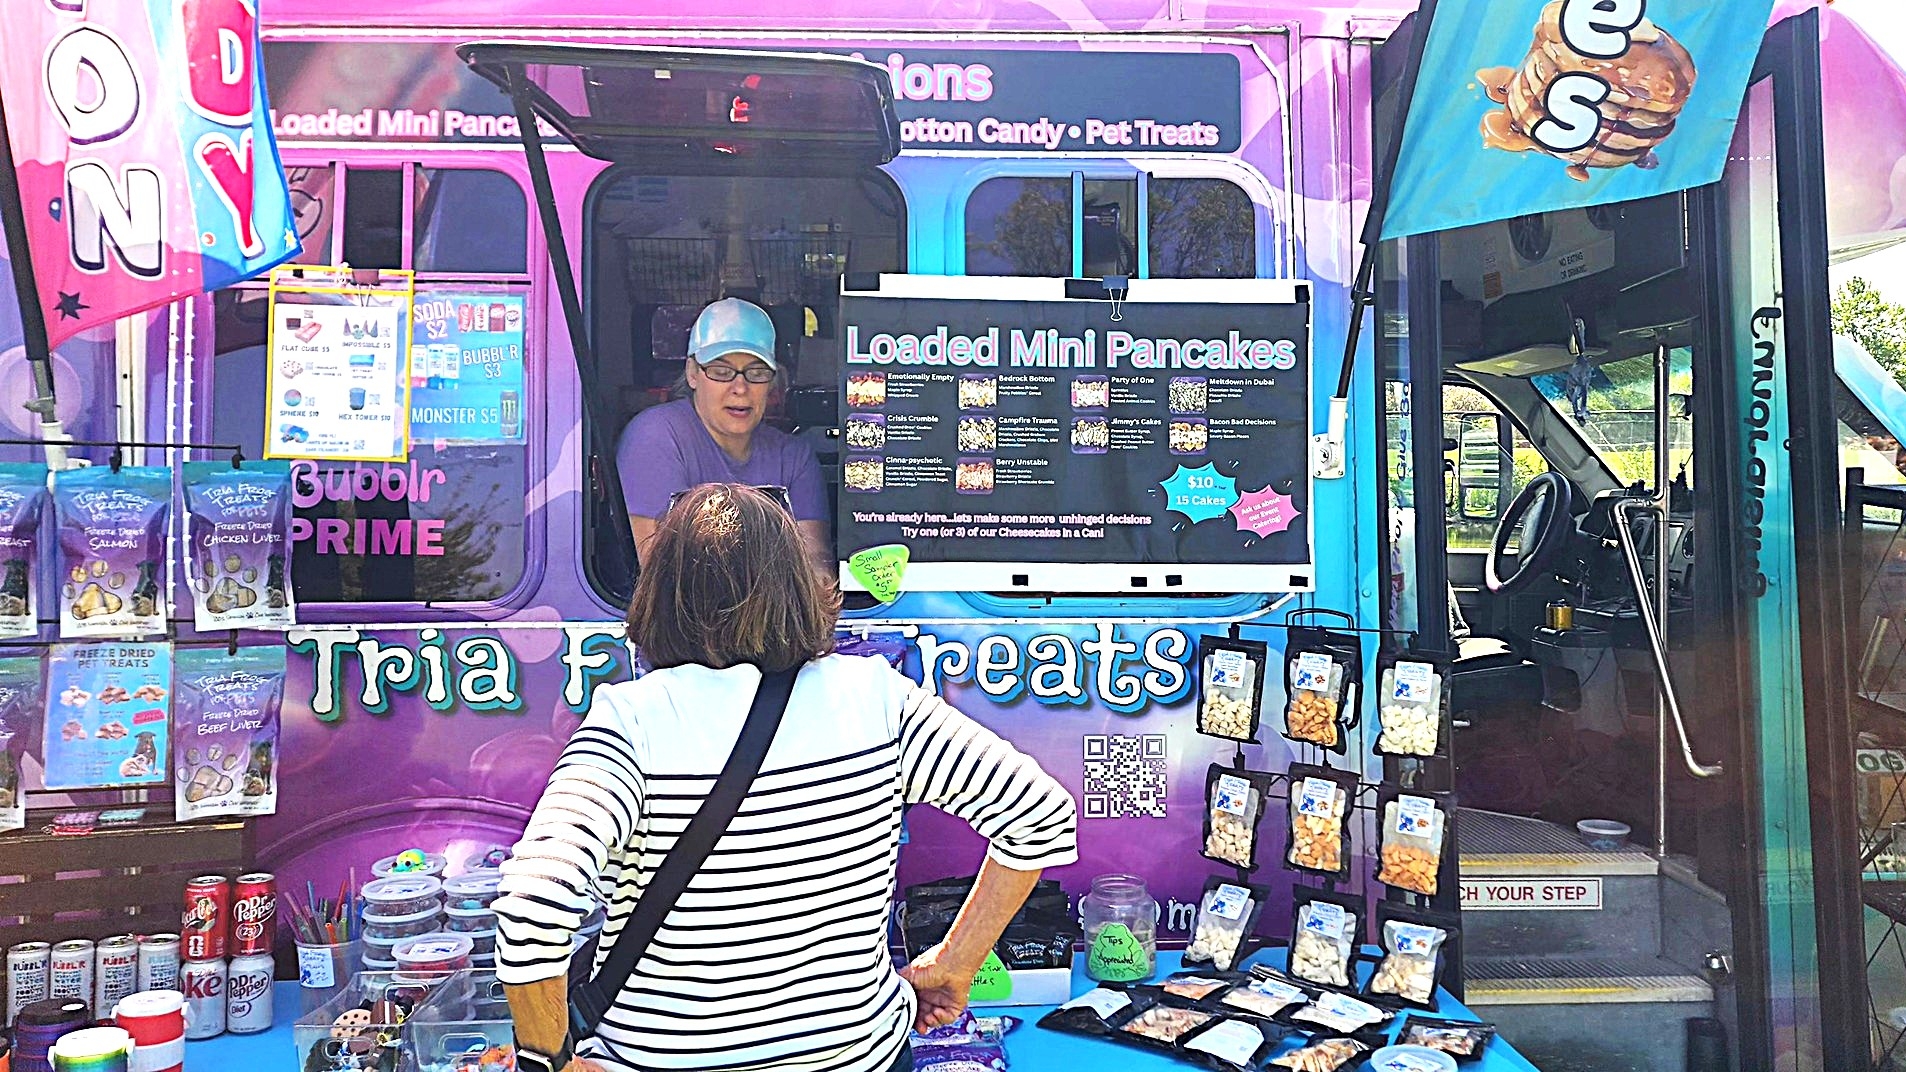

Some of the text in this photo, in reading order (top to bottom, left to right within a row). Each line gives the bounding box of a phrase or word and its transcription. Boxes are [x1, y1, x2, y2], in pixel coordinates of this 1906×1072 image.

[887, 53, 994, 101] ions
[269, 108, 374, 137] Loaded
[378, 108, 440, 137] Mini
[43, 0, 165, 279] ON
[900, 117, 1220, 150] otton Candy Pet Treats
[412, 300, 456, 323] SODA
[846, 326, 1297, 371] Loaded Mini Pancakes
[887, 373, 954, 383] Emotionally Empty
[998, 375, 1055, 383] Bedrock Bottom
[1111, 376, 1128, 386] Party
[1130, 376, 1138, 384] of
[1209, 378, 1275, 386] Meltdown in Dubai
[412, 407, 476, 424] MONSTER
[887, 415, 939, 423] Crisis Crumble
[998, 416, 1058, 425] Campfire Trauma
[1111, 417, 1162, 427] Jimmy's Cakes
[886, 457, 942, 465] Cinna-psychotic
[996, 459, 1016, 468] Berry
[1187, 475, 1214, 489] $10
[202, 486, 233, 500] TRIA
[85, 500, 144, 513] TREATS
[211, 494, 269, 508] TREATS
[1175, 495, 1227, 506] 15 Cakes
[1241, 507, 1255, 515] Ask
[1261, 497, 1281, 509] about
[852, 512, 885, 524] You're
[885, 512, 923, 525] already
[973, 514, 1000, 524] make
[1000, 514, 1028, 524] some
[1029, 514, 1055, 524] more
[1058, 513, 1105, 526] unhinged
[1106, 513, 1152, 525] decisions
[1259, 507, 1279, 518] Event
[214, 522, 246, 532] FREEZE
[901, 527, 918, 538] Try
[919, 528, 939, 537] one
[940, 527, 955, 538] (or
[967, 527, 978, 538] of
[979, 528, 998, 538] our
[998, 527, 1061, 538] Cheesecakes
[1081, 527, 1104, 538] Can!
[89, 536, 138, 550] SALMON
[203, 532, 283, 547] CHICKEN LIVER
[292, 518, 445, 556] PRIME
[855, 551, 883, 567] Small
[73, 648, 156, 659] FREEZE DRIED
[102, 659, 149, 669] TREATS
[863, 623, 1190, 707] reats
[286, 628, 519, 718] Tria
[202, 682, 260, 696] TREATS
[197, 720, 263, 736] BEEF LIVER
[1486, 886, 1535, 901] YOUR
[1542, 886, 1587, 901] STEP
[249, 896, 268, 907] Dr
[237, 898, 276, 923] Pepper
[1103, 935, 1124, 946] Tips
[179, 971, 222, 999] ke
[239, 974, 257, 984] Dr
[229, 976, 267, 1000] Pepper
